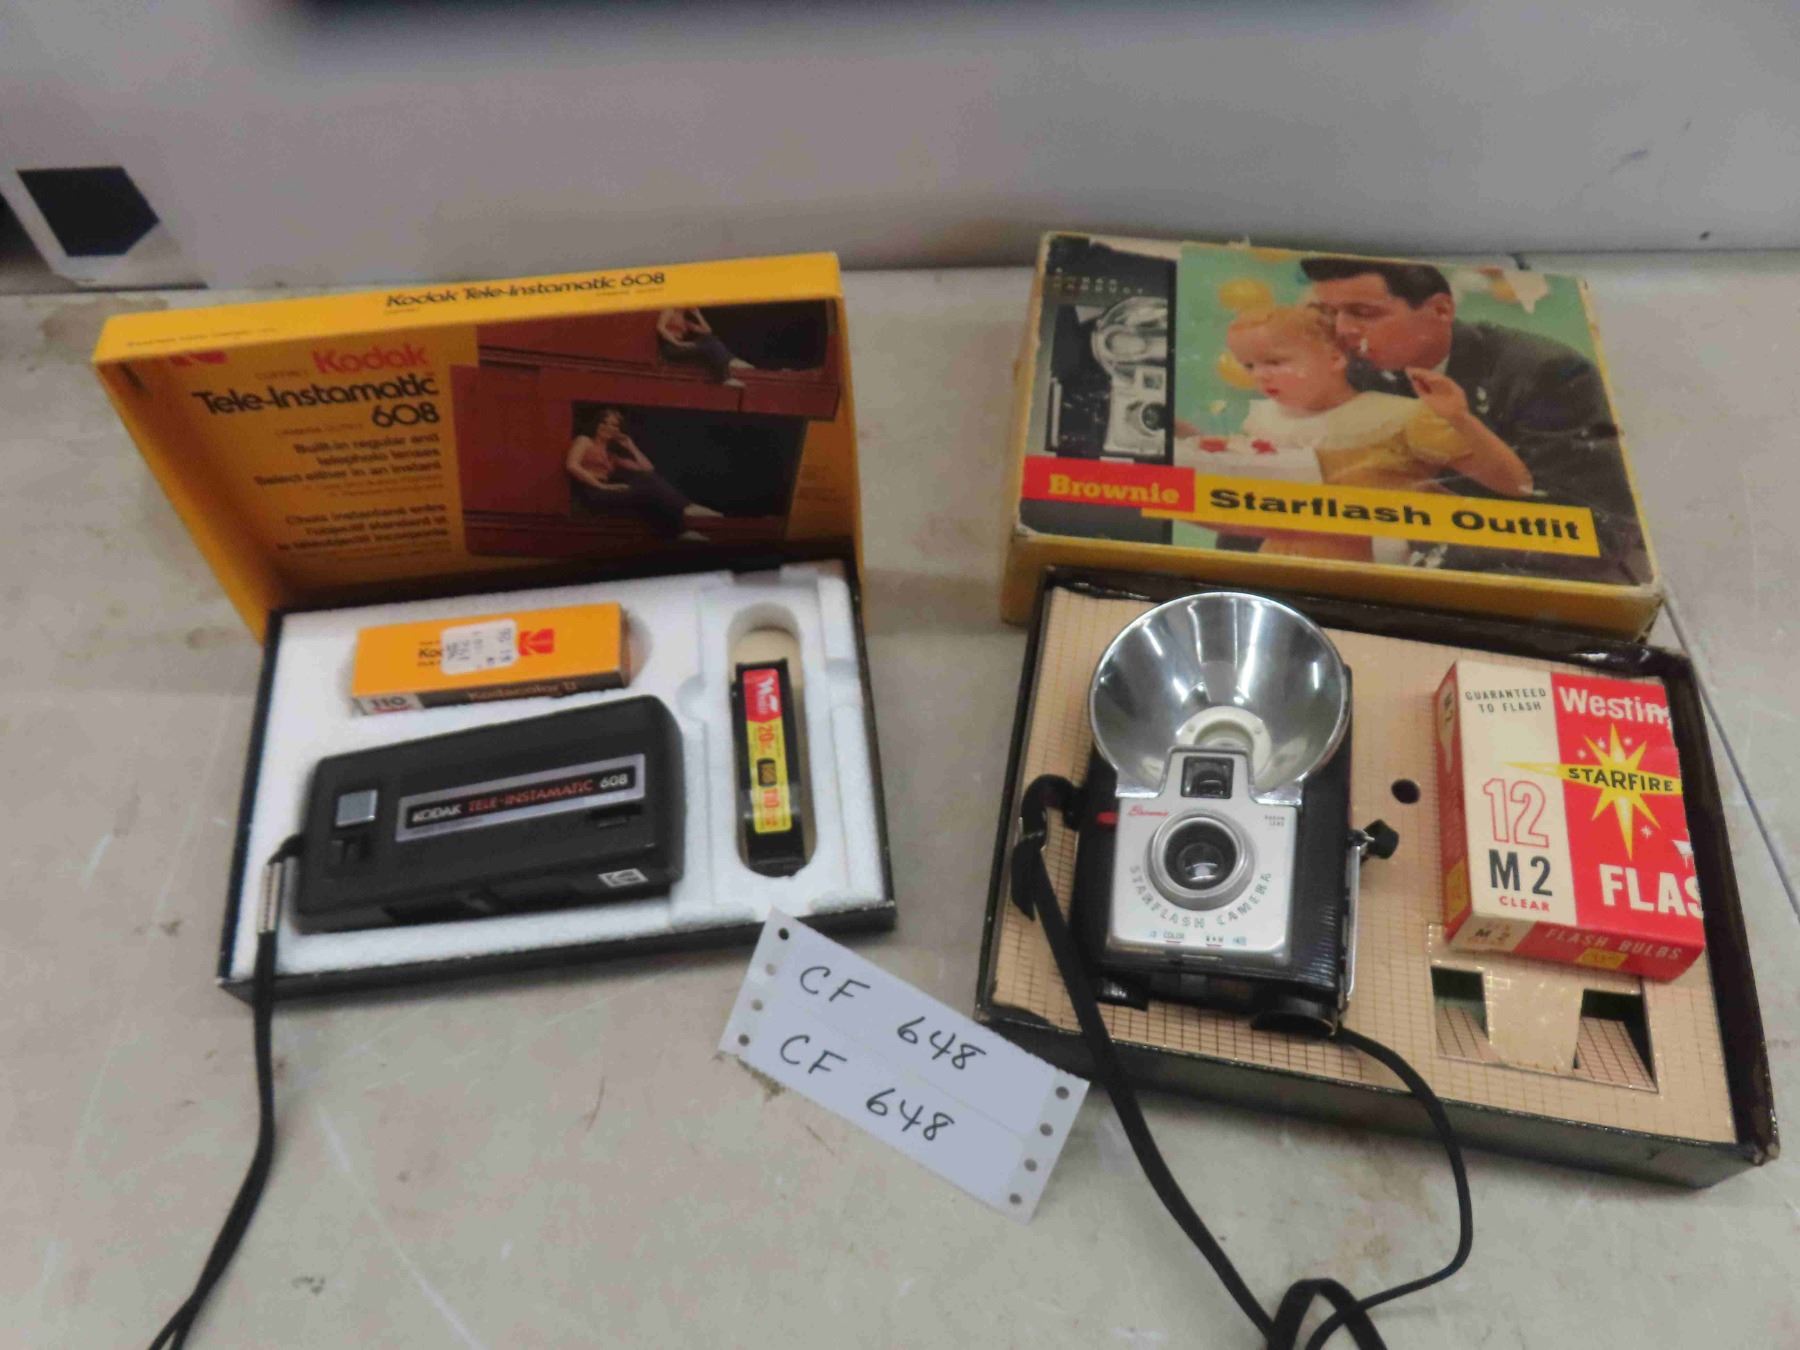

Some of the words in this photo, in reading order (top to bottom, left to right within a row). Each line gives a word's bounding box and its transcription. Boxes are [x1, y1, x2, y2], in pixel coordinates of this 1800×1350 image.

[386, 290, 458, 307] Kodak
[464, 276, 616, 300] Tele-Instamatic
[621, 272, 665, 287] 608
[312, 344, 429, 374] Kodak
[191, 373, 440, 415] Tele-Instamatic
[371, 402, 440, 427] 608
[1048, 473, 1180, 504] Brownie
[1209, 487, 1432, 526] Starflash
[1451, 510, 1581, 540] Outfit
[370, 695, 407, 709] 110
[1464, 687, 1547, 702] GUARANTEED
[1478, 702, 1495, 713] TO
[1502, 699, 1542, 713] FLASH
[1567, 766, 1675, 793] STARFIRE
[411, 804, 462, 824] KODAK
[600, 772, 629, 788] 608
[1482, 777, 1550, 849] 12
[1129, 865, 1205, 929] STARFLASH
[1216, 872, 1273, 926] CAMERA
[1499, 895, 1551, 912] CLEAR
[1544, 928, 1608, 948] FLASH
[1618, 940, 1683, 961] BULBS
[799, 966, 871, 1002] CF
[896, 1016, 987, 1070] 648
[780, 1035, 848, 1075] CF
[866, 1088, 956, 1141] 648
